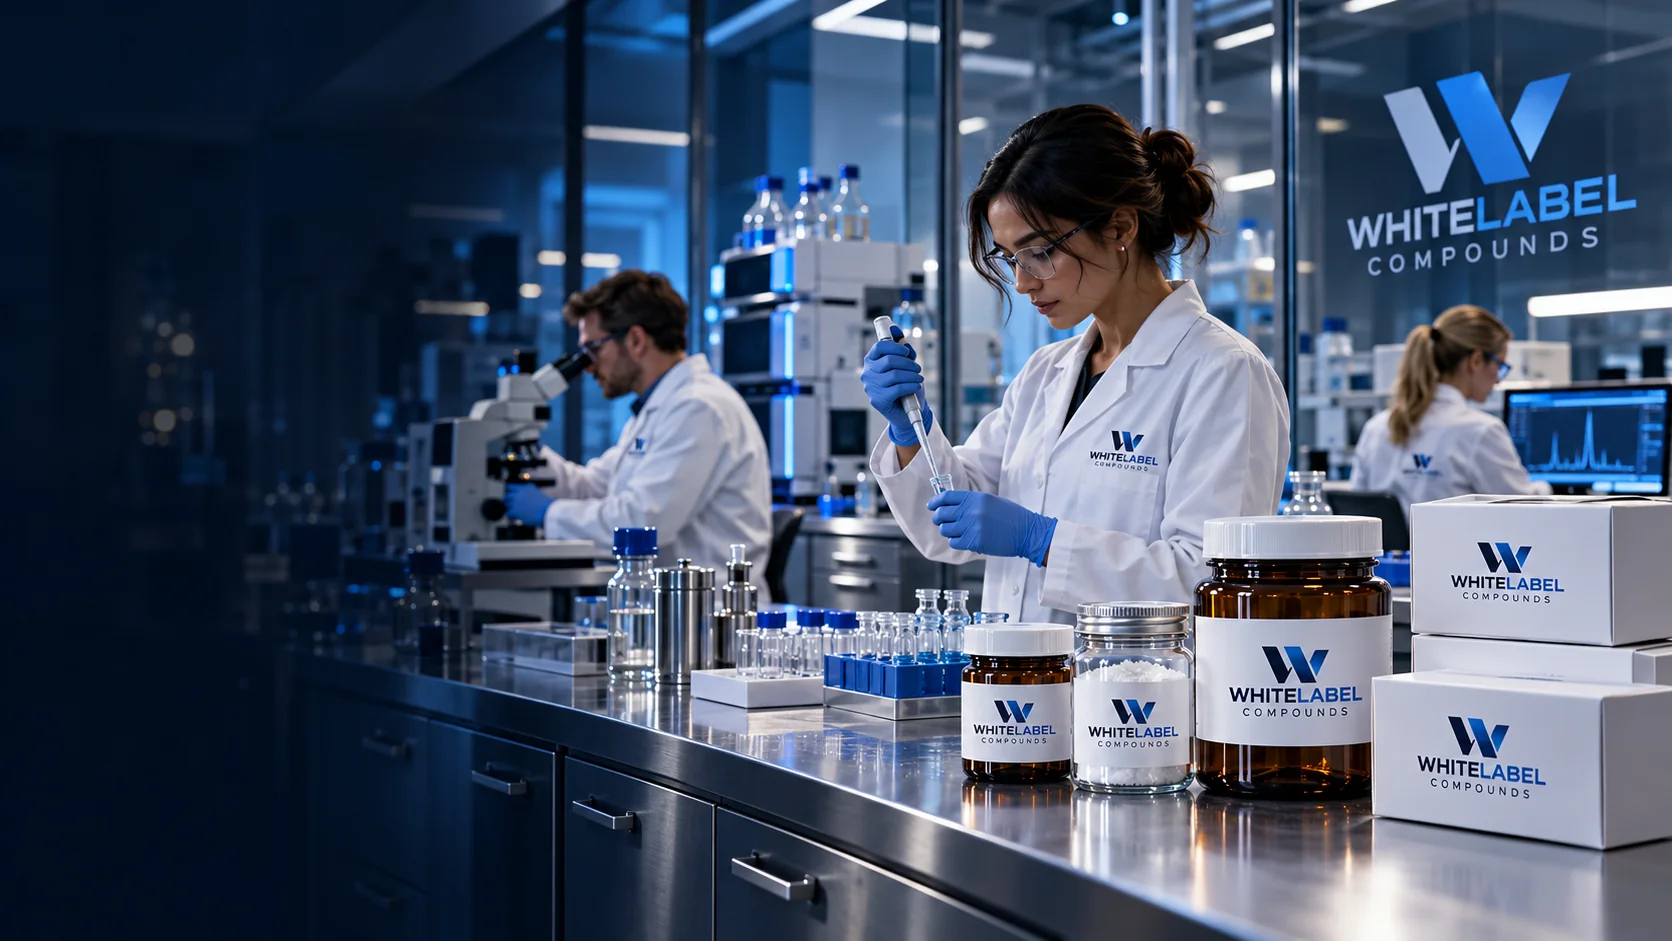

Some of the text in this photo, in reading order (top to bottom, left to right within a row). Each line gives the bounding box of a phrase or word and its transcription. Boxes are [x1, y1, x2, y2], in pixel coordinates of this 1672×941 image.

[1347, 173, 1637, 251] WHITELABEL
[1367, 225, 1599, 276] COMPOUNDS
[1089, 451, 1158, 466] WHITELABEL
[1450, 574, 1565, 593] WHITELABEL
[1462, 591, 1551, 604] COMPOUNDS
[1229, 686, 1363, 704] WHITELABEL
[1242, 706, 1348, 718] COMPOUNDS
[973, 724, 1056, 736] WHITELABEL
[1088, 725, 1179, 738] WHITELABEL
[981, 736, 1047, 745] COMPOUNDS
[1097, 740, 1170, 748] COMPOUNDS
[1417, 755, 1546, 786] WHITELABEL
[1430, 777, 1530, 799] COMPOUNDS
